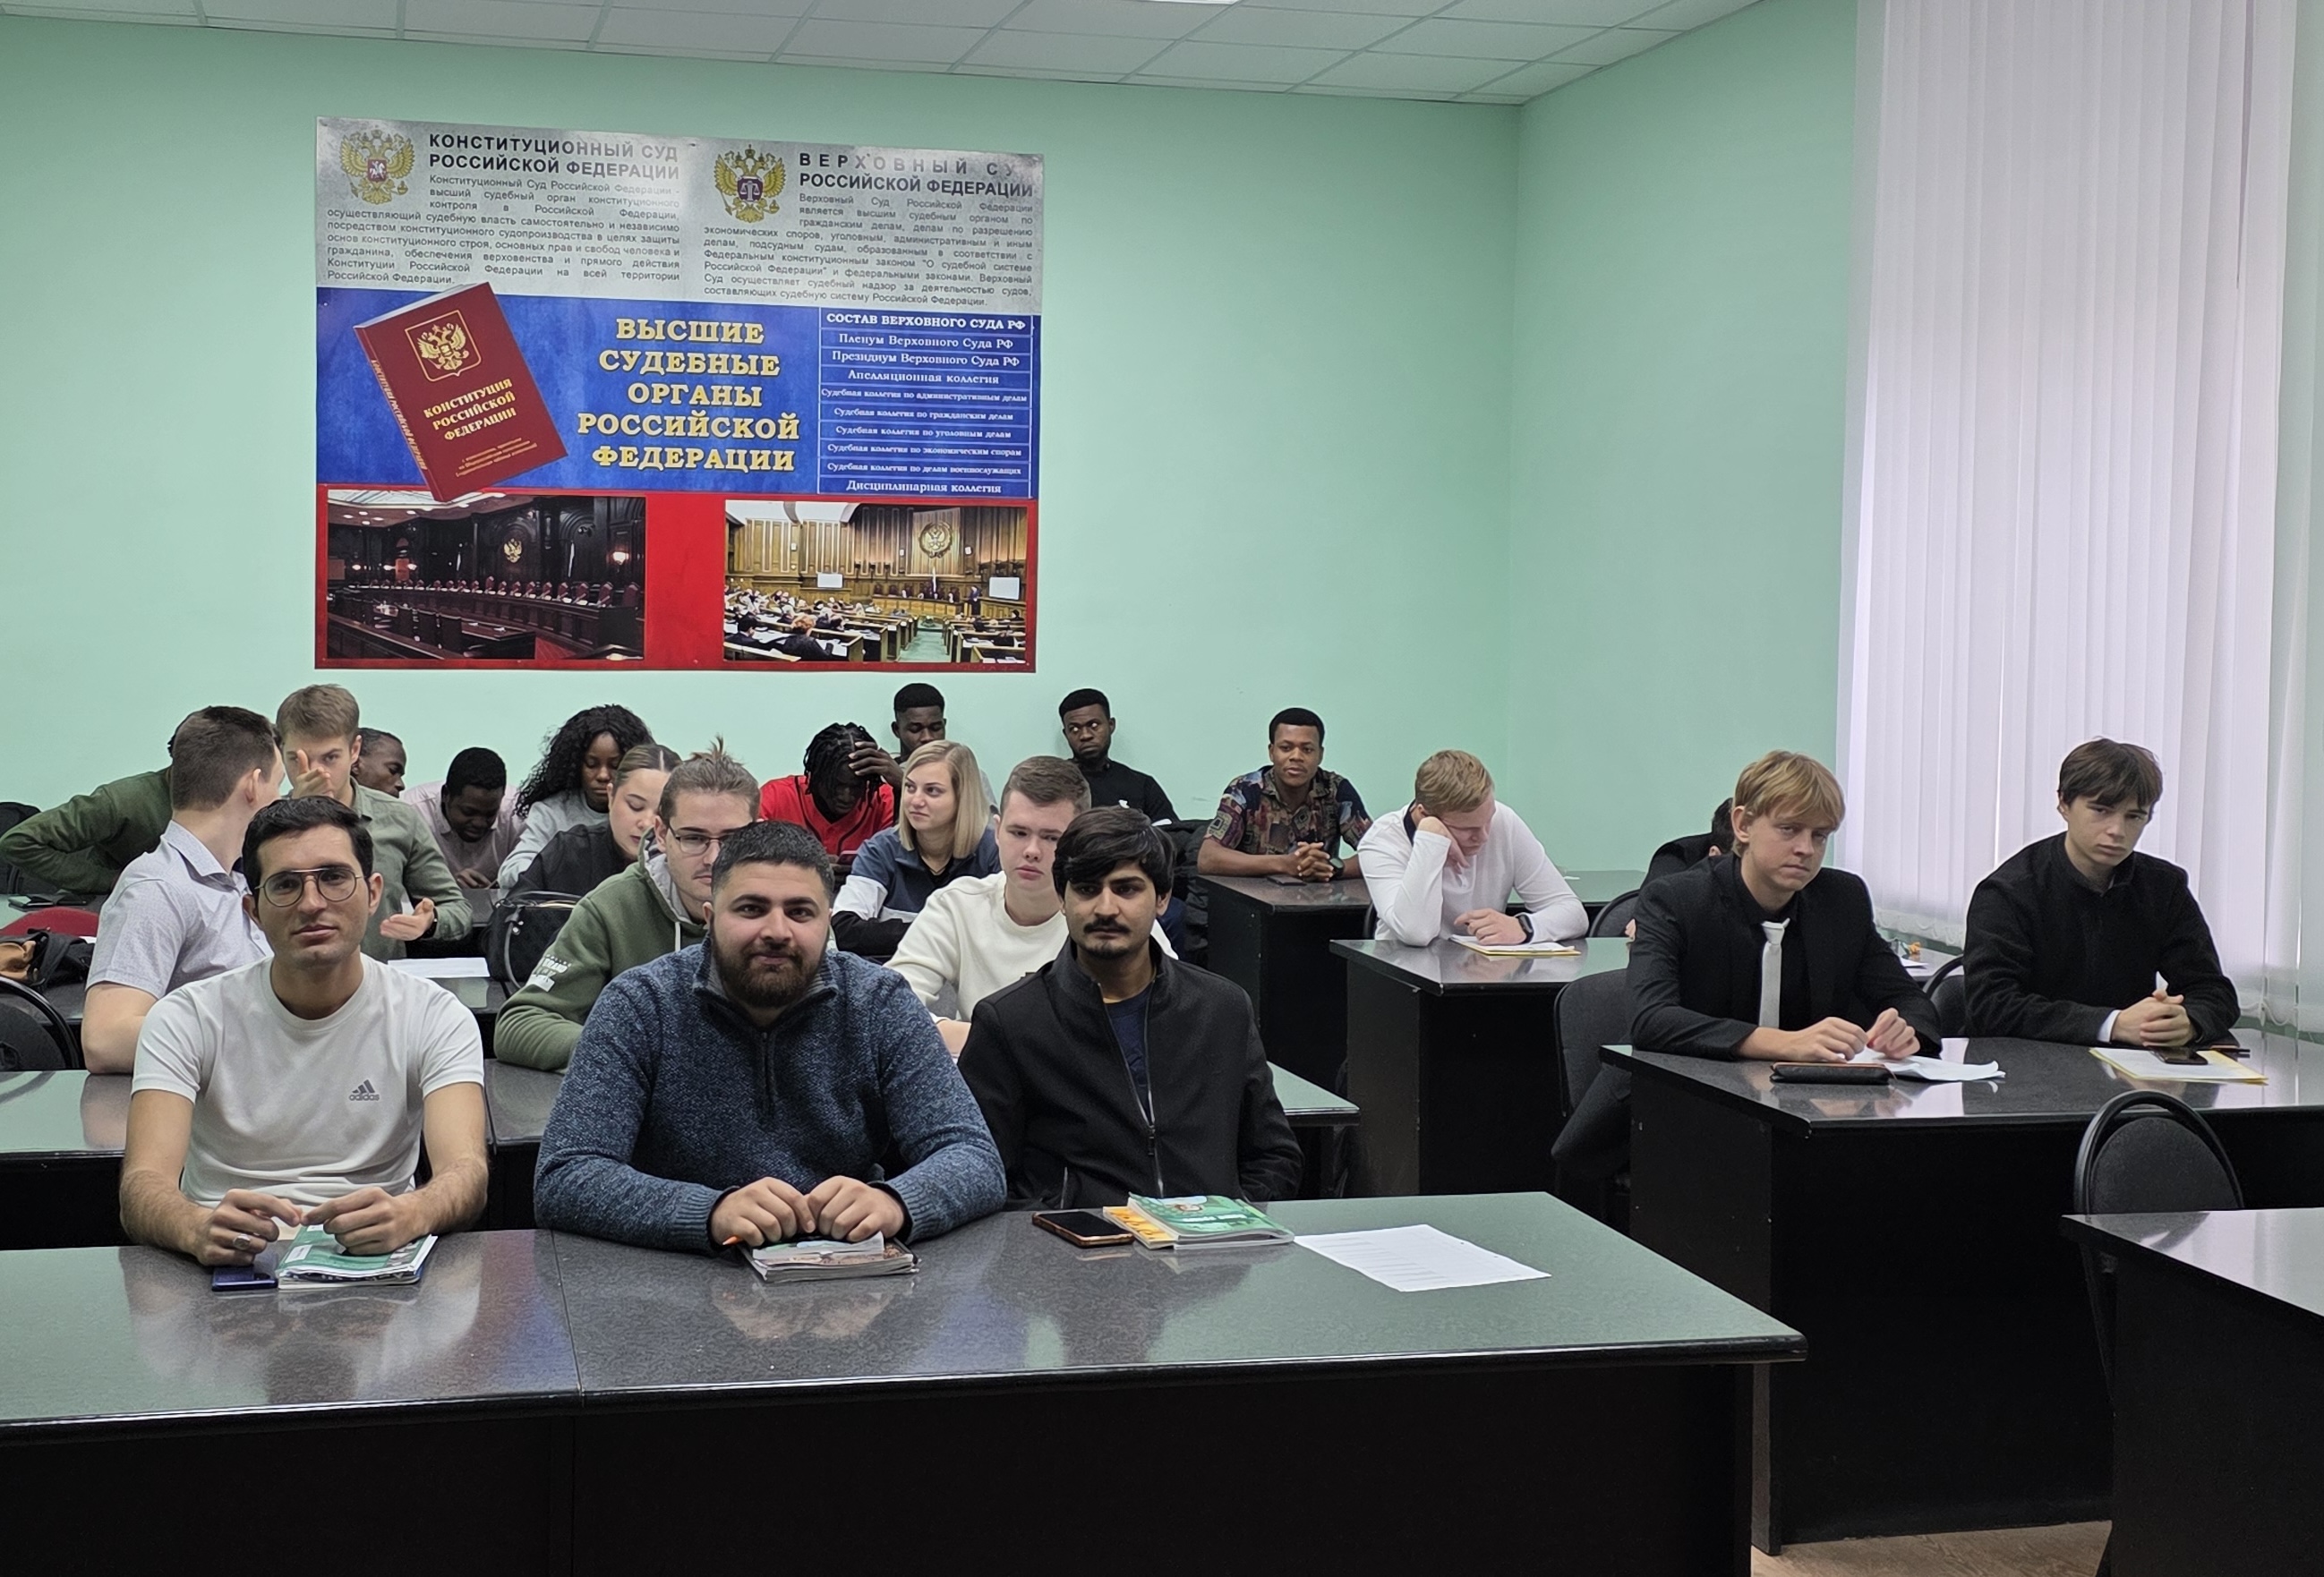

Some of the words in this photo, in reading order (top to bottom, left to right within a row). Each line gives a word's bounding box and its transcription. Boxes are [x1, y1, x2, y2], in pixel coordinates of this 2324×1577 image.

[430, 134, 633, 158] КОНСТИТУЦИОННЫЙ
[642, 144, 678, 162] СУД
[430, 154, 560, 173] РОССИЙСКОЙ
[566, 161, 679, 180] ФЕДЕРАЦИИ
[799, 153, 967, 175] ВЕРХОВНЫЙ
[429, 173, 522, 187] Конституционный
[526, 178, 547, 191] Суд
[551, 179, 610, 192] Российской
[799, 173, 920, 192] РОССИЙСКОЙ
[927, 179, 1033, 197] ФЕДЕРАЦИИ
[430, 188, 471, 197] высший
[483, 190, 534, 200] судебный
[546, 194, 576, 203] орган
[799, 192, 854, 204] Верховный
[871, 196, 890, 208] Суд
[906, 197, 961, 209] Российской
[978, 200, 1032, 214] Федерации
[429, 200, 477, 211] контроля
[534, 203, 594, 216] Российской
[799, 208, 843, 216] является
[857, 209, 895, 217] высшим
[909, 210, 956, 221] судебным
[969, 215, 1008, 224] органом
[327, 209, 421, 221] осуществляющий
[425, 212, 476, 225] судебную
[481, 216, 516, 225] власть
[520, 217, 604, 228] самостоятельно
[619, 222, 679, 232] независимо
[799, 219, 862, 228] гражданским
[912, 224, 943, 233] делам
[971, 226, 1032, 237] разрешению
[327, 221, 396, 232] посредством
[400, 225, 494, 236] конституционного
[499, 229, 593, 241] судопроизводства
[606, 234, 637, 243] целях
[640, 235, 679, 244] защиты
[704, 226, 778, 237] экономических
[893, 235, 986, 246] административным
[327, 234, 358, 242] основ
[362, 235, 456, 247] конституционного
[495, 242, 544, 250] основных
[548, 243, 572, 253] прав
[584, 243, 620, 255] свобод
[623, 247, 671, 256] человека
[749, 241, 804, 251] подсудным
[857, 243, 927, 255] образованным
[953, 250, 1016, 260] соответствии
[404, 248, 472, 260] обеспечения
[483, 253, 553, 263] верховенства
[580, 257, 622, 267] прямого
[632, 258, 679, 268] действия
[704, 248, 774, 261] Федеральным
[782, 254, 868, 265] конституционным
[876, 259, 915, 267] законом
[941, 260, 986, 270] судебной
[327, 257, 395, 270] Конституции
[409, 260, 470, 271] Российской
[484, 263, 543, 276] Федерации
[583, 268, 607, 277] всей
[620, 271, 679, 282] территории
[327, 269, 389, 281] Российской
[704, 260, 762, 272] Российской
[844, 267, 919, 279] федеральными
[979, 272, 1032, 285] Верховный
[704, 273, 723, 284] Суд
[731, 277, 799, 286] осуществляет
[807, 277, 855, 289] судебный
[862, 282, 896, 292] надзор
[921, 285, 995, 294] деятельностью
[704, 287, 776, 297] составляющих
[780, 288, 827, 301] судебную
[830, 293, 869, 303] систему
[872, 292, 927, 303] Российской
[616, 318, 765, 345] ВЫСШИЕ
[826, 312, 877, 324] СОСТАВ
[881, 315, 966, 328] ВЕРХОВНОГО
[969, 319, 1004, 329] СУДА
[1007, 320, 1025, 329] РФ
[839, 333, 884, 345] Пленум
[888, 335, 959, 347] Верховного
[962, 337, 992, 350] Суда
[996, 338, 1013, 349] РФ
[599, 349, 781, 376] СУДЕБНЫЕ
[832, 350, 897, 364] Президиум
[901, 352, 968, 365] Верховного
[970, 354, 999, 367] Суда
[1003, 356, 1020, 366] РФ
[848, 369, 942, 381] Апелляционная
[946, 375, 998, 383] коллегия
[423, 379, 512, 418] КОНСТИТУЦИЯ
[628, 382, 763, 406] ОРГАНЫ
[432, 391, 516, 430] РОССИЙСКОЙ
[444, 407, 517, 440] ФЕДЕРАЦИИ
[577, 410, 799, 439] РОССИЙСКОЙ
[592, 446, 795, 473] ФЕДЕРАЦИИ
[846, 480, 947, 493] Дисциплинарная
[951, 484, 1001, 492] коллегия
[349, 1092, 380, 1101] adidas
